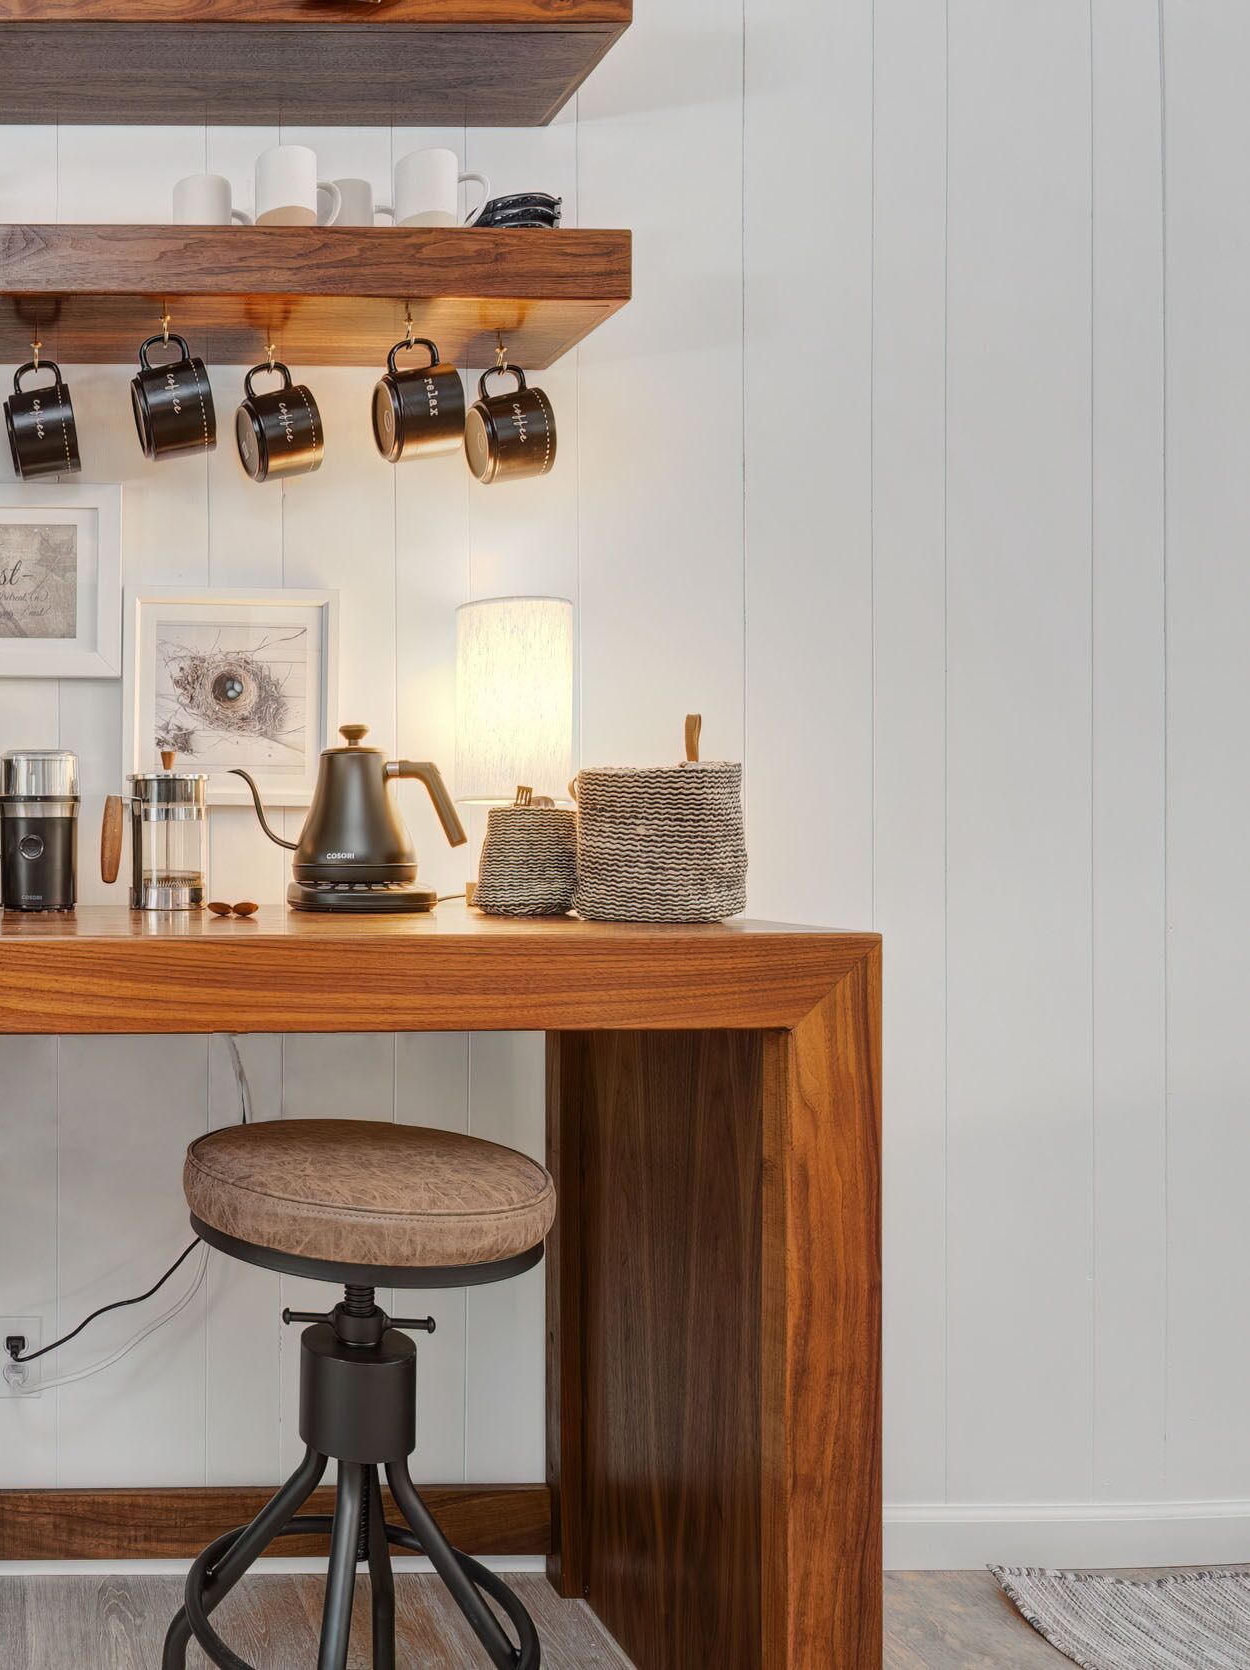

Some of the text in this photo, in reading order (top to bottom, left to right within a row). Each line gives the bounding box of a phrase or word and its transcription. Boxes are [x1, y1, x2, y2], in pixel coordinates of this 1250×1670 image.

[164, 373, 182, 415] coffee
[424, 377, 439, 417] relax
[29, 399, 46, 440] coffee
[278, 402, 294, 442] coffee
[511, 403, 528, 443] coffee
[326, 852, 355, 860] COSORI
